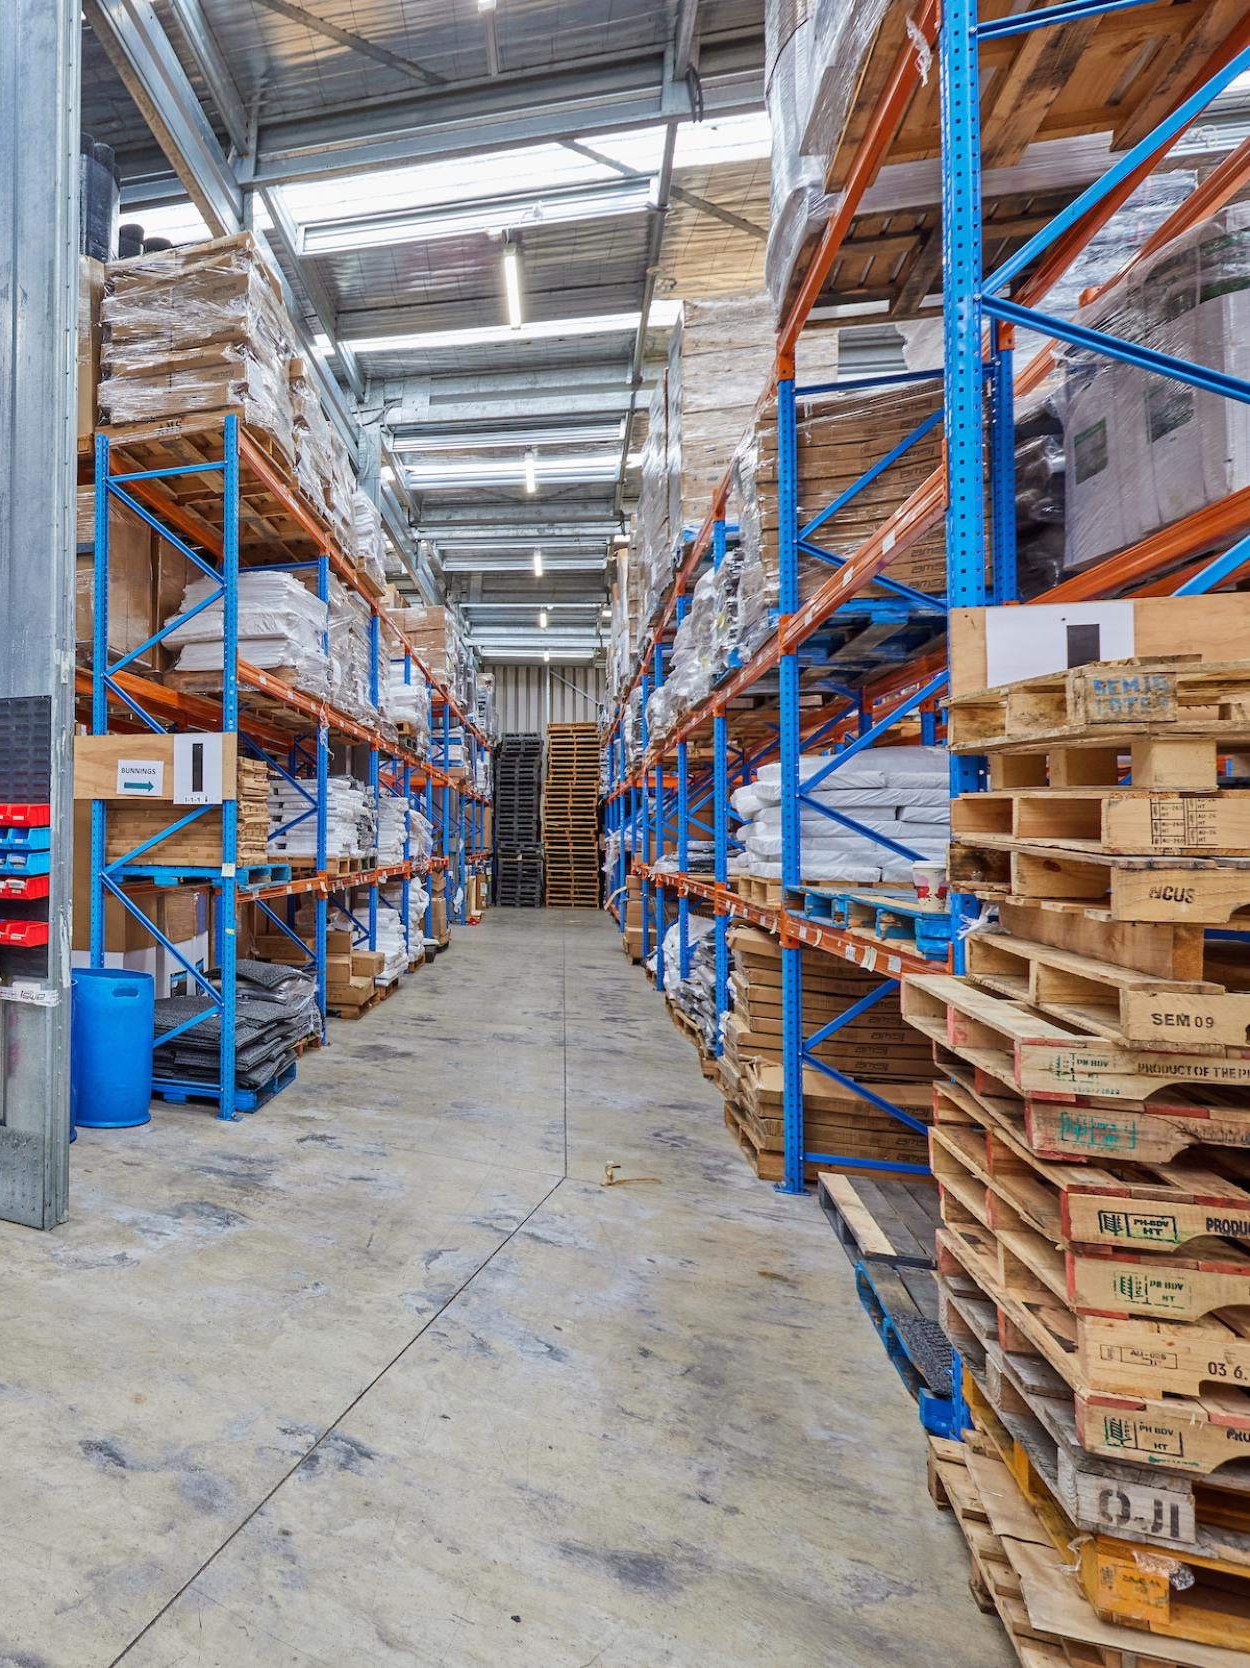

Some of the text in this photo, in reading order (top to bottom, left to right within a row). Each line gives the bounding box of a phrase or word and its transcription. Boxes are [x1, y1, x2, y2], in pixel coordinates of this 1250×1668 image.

[121, 766, 157, 775] BUNNINGS
[191, 743, 204, 793] I
[1150, 1013, 1215, 1028] SEM 09
[1137, 1062, 1192, 1076] PRODUCT
[1194, 1065, 1210, 1077] OF
[1213, 1067, 1237, 1079] THE
[1143, 1228, 1163, 1236] HT
[1206, 1217, 1250, 1236] PRODU
[1207, 1361, 1227, 1377] 03
[1138, 1424, 1153, 1433] PH
